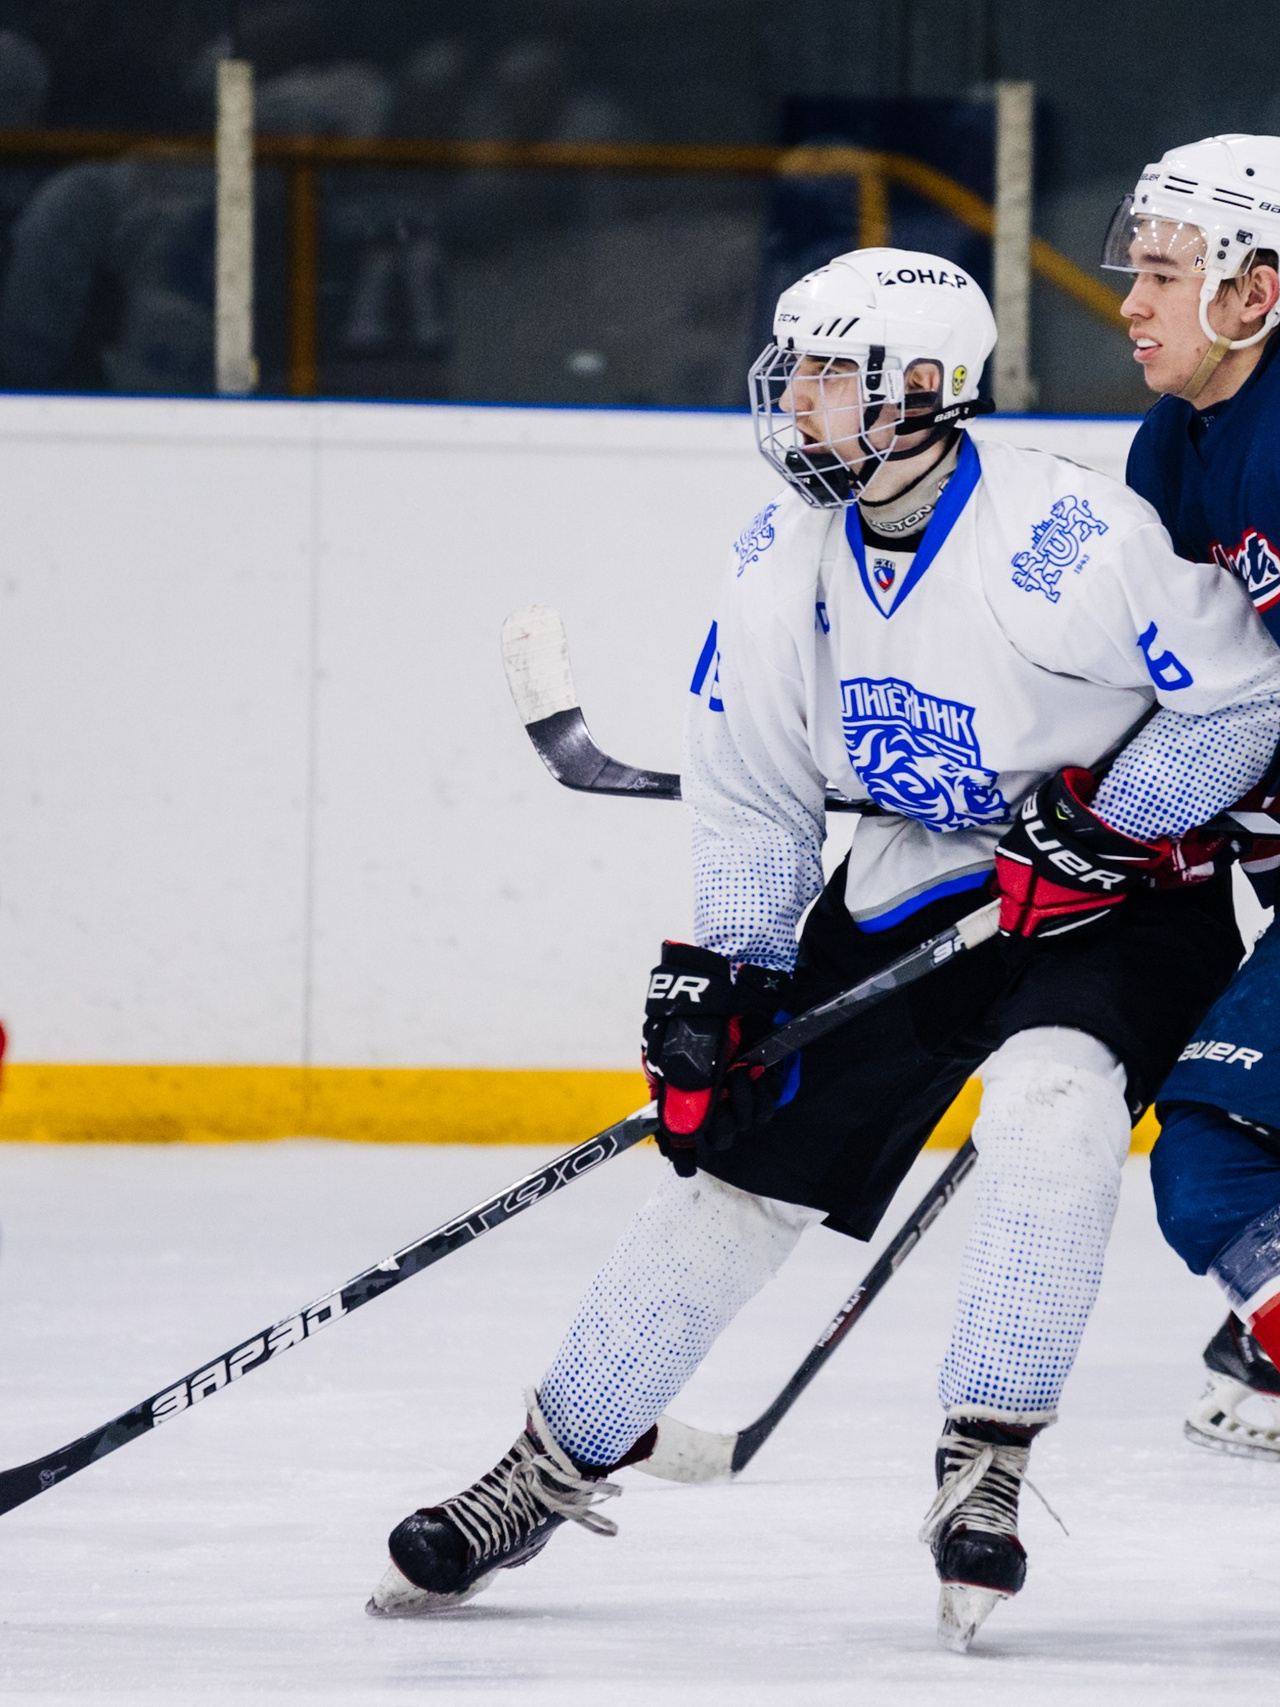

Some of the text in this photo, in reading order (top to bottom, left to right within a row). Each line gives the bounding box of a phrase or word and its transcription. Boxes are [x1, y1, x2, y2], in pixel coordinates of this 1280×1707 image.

[933, 407, 970, 423] BAUR
[869, 503, 935, 533] ASTON
[841, 682, 975, 747] ЛИТЕХНИК
[1177, 1039, 1264, 1070] AUER
